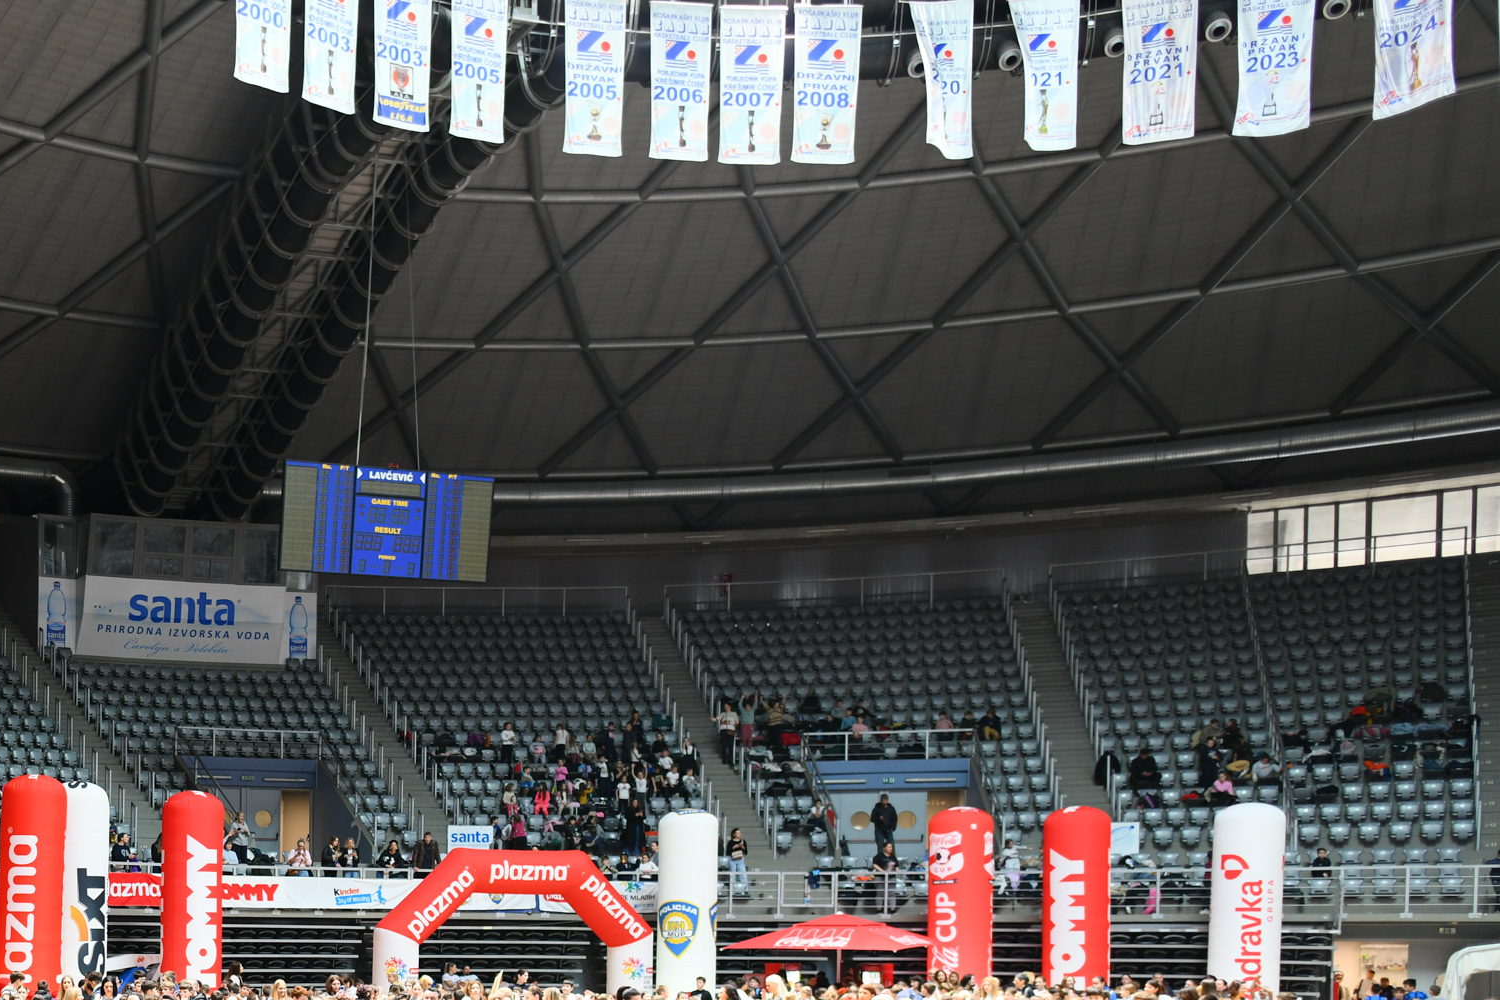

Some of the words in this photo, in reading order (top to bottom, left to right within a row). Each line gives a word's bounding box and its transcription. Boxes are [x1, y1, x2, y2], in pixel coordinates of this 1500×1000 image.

[1380, 14, 1445, 49] 2024.
[377, 42, 427, 67] 2003.
[1248, 43, 1296, 57] PRVAK
[1134, 54, 1180, 68] PRVAK
[1245, 51, 1307, 74] 2023.
[453, 61, 503, 84] 2005.
[573, 73, 615, 83] PRVAK
[797, 71, 855, 82] DRŽAVNI
[1129, 62, 1191, 85] 2021.
[568, 81, 621, 101] 2005.
[654, 85, 706, 104] 2006.
[803, 82, 848, 91] PRVAK
[722, 91, 779, 107] 2007.
[797, 91, 854, 108] 2008.
[389, 112, 413, 123] LIGA
[369, 468, 414, 482] LAVČEVIĆ
[371, 498, 391, 506] GAME
[393, 499, 409, 507] TIME
[374, 526, 402, 535] RESULT
[128, 591, 236, 626] santa
[97, 624, 162, 637] PRIRODNA
[169, 628, 231, 639] IZVORSKA
[236, 631, 271, 641] VODA
[450, 829, 490, 844] santa
[489, 860, 568, 884] plazma
[352, 895, 371, 904] moving
[406, 869, 475, 941] plazma
[580, 874, 645, 939] plazma
[629, 894, 655, 902] MLADIH
[1266, 880, 1275, 922] GRUPA
[186, 834, 218, 988] TOMMY
[659, 903, 698, 917] POLICIJA
[935, 892, 957, 942] CUP
[667, 920, 685, 931] RH
[1050, 848, 1086, 990] TOMMY
